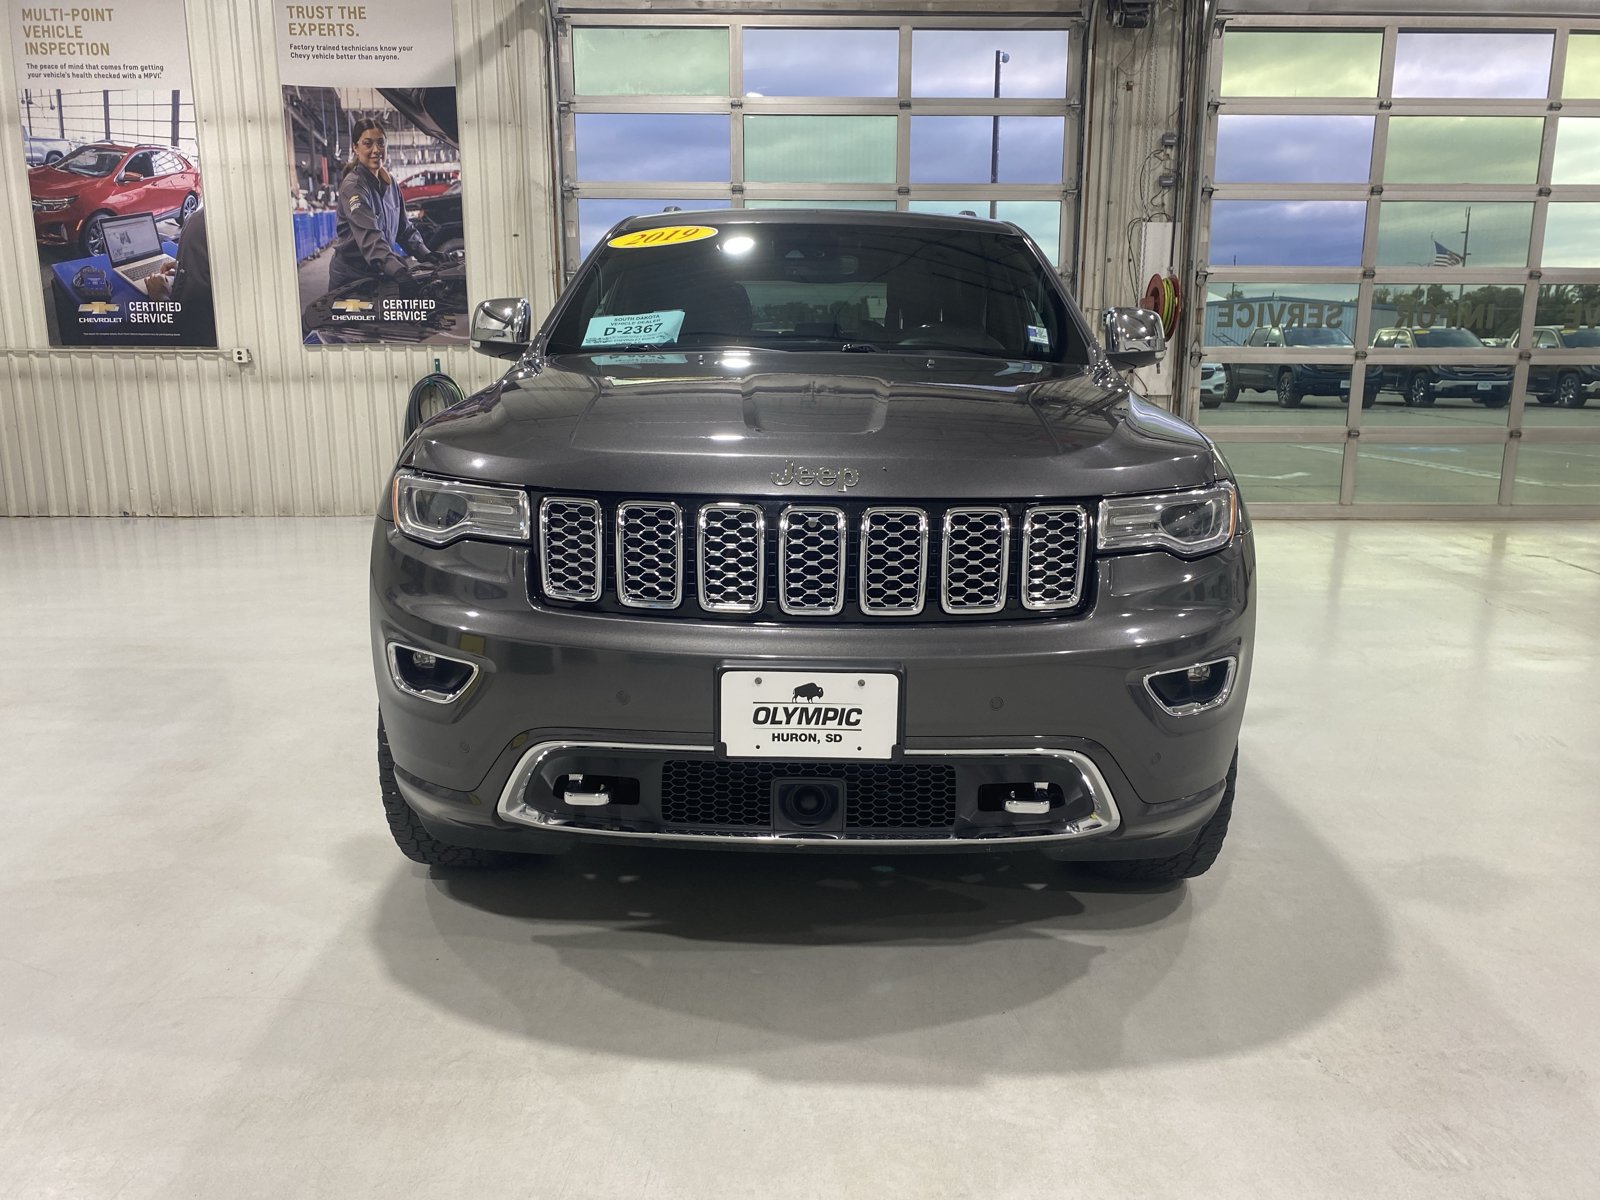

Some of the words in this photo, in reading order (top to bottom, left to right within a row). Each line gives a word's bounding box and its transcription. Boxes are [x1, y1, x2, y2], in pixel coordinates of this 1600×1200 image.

[22, 8, 114, 21] MULTI-POINT
[286, 6, 333, 19] TRUST
[338, 6, 366, 20] THE
[22, 25, 83, 38] VEHICLE
[288, 23, 360, 36] EXPERTS.
[24, 42, 110, 56] INSPECTION
[290, 44, 314, 52] Factory
[290, 52, 310, 60] Chevy
[140, 64, 164, 72] getting
[624, 228, 700, 246] 2019
[129, 302, 182, 312] CERTIFIED
[382, 300, 436, 310] CERTIFIED
[130, 313, 174, 324] SERVICE
[384, 311, 428, 320] SERVICE
[604, 323, 663, 336] D-2367
[771, 458, 859, 492] Jeep
[752, 706, 862, 726] OLYMPIC
[772, 733, 820, 744] HURON,
[826, 734, 842, 742] SD
